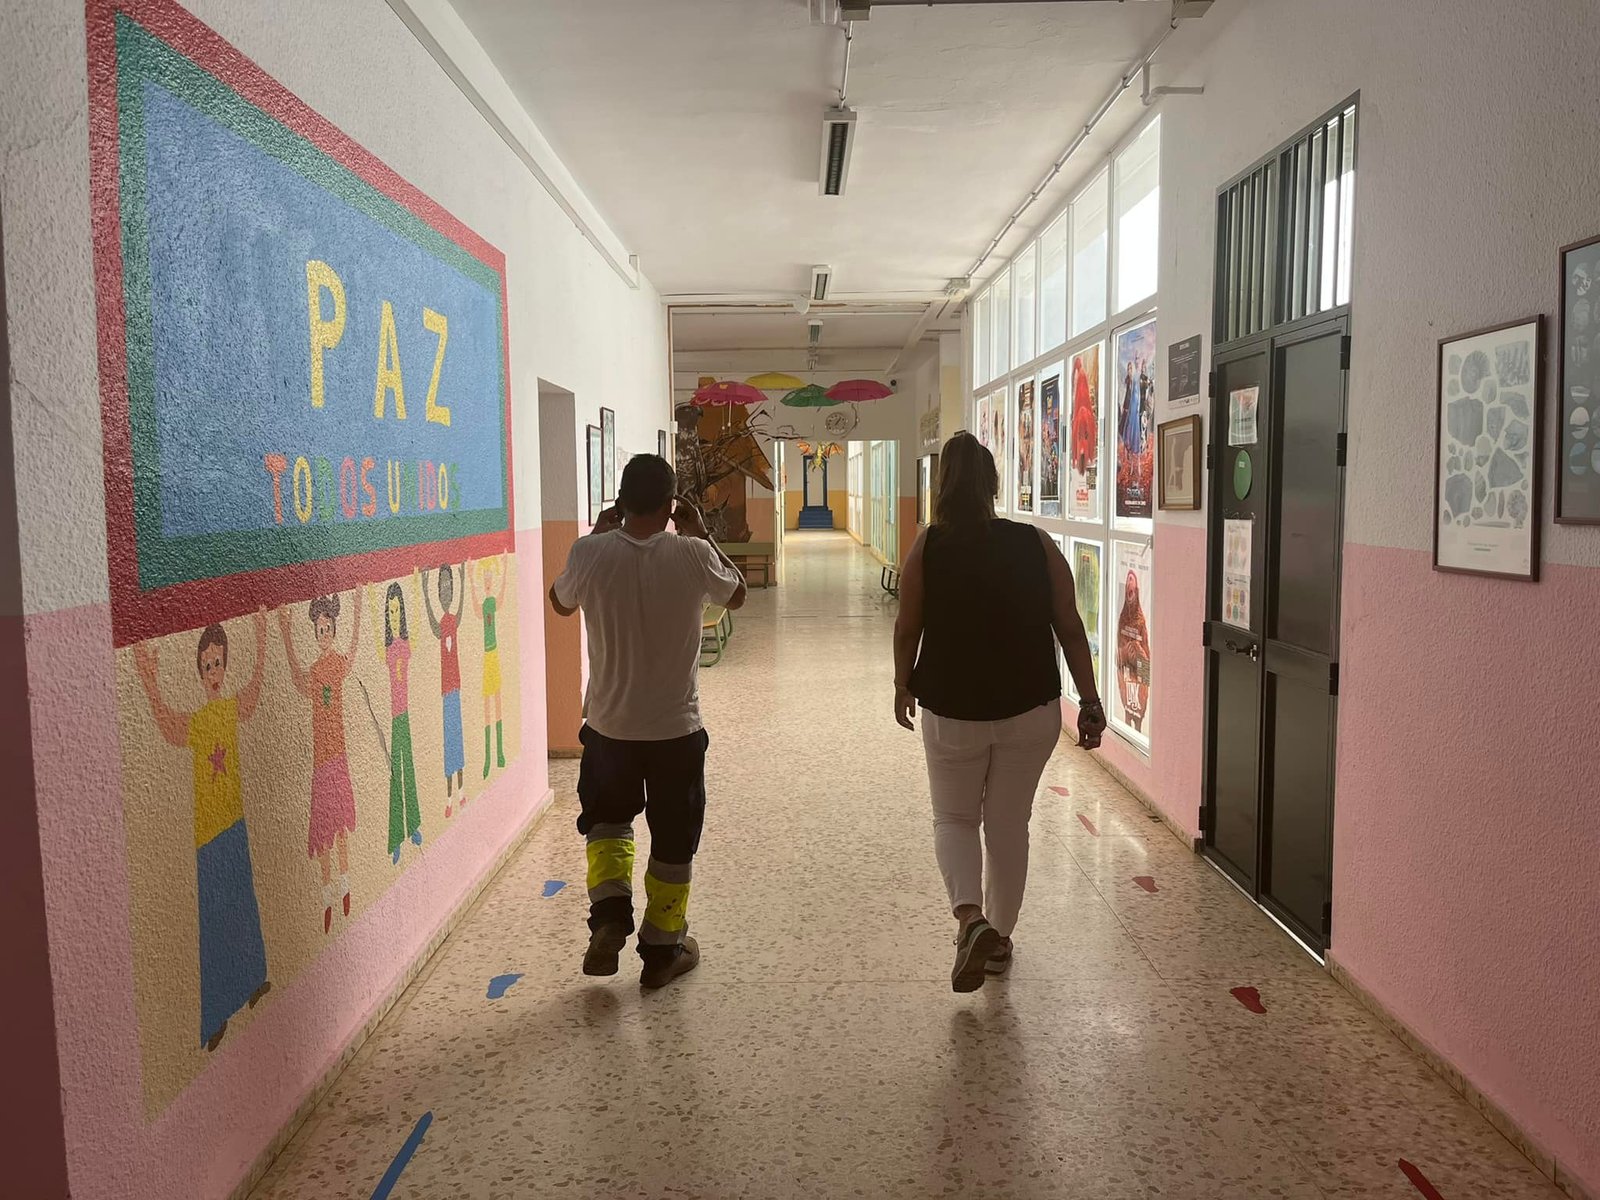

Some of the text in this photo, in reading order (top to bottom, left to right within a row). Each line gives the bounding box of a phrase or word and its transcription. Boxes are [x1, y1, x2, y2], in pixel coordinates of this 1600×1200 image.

[306, 260, 451, 427] PAZ
[264, 453, 461, 525] TODOS UNIDOS
